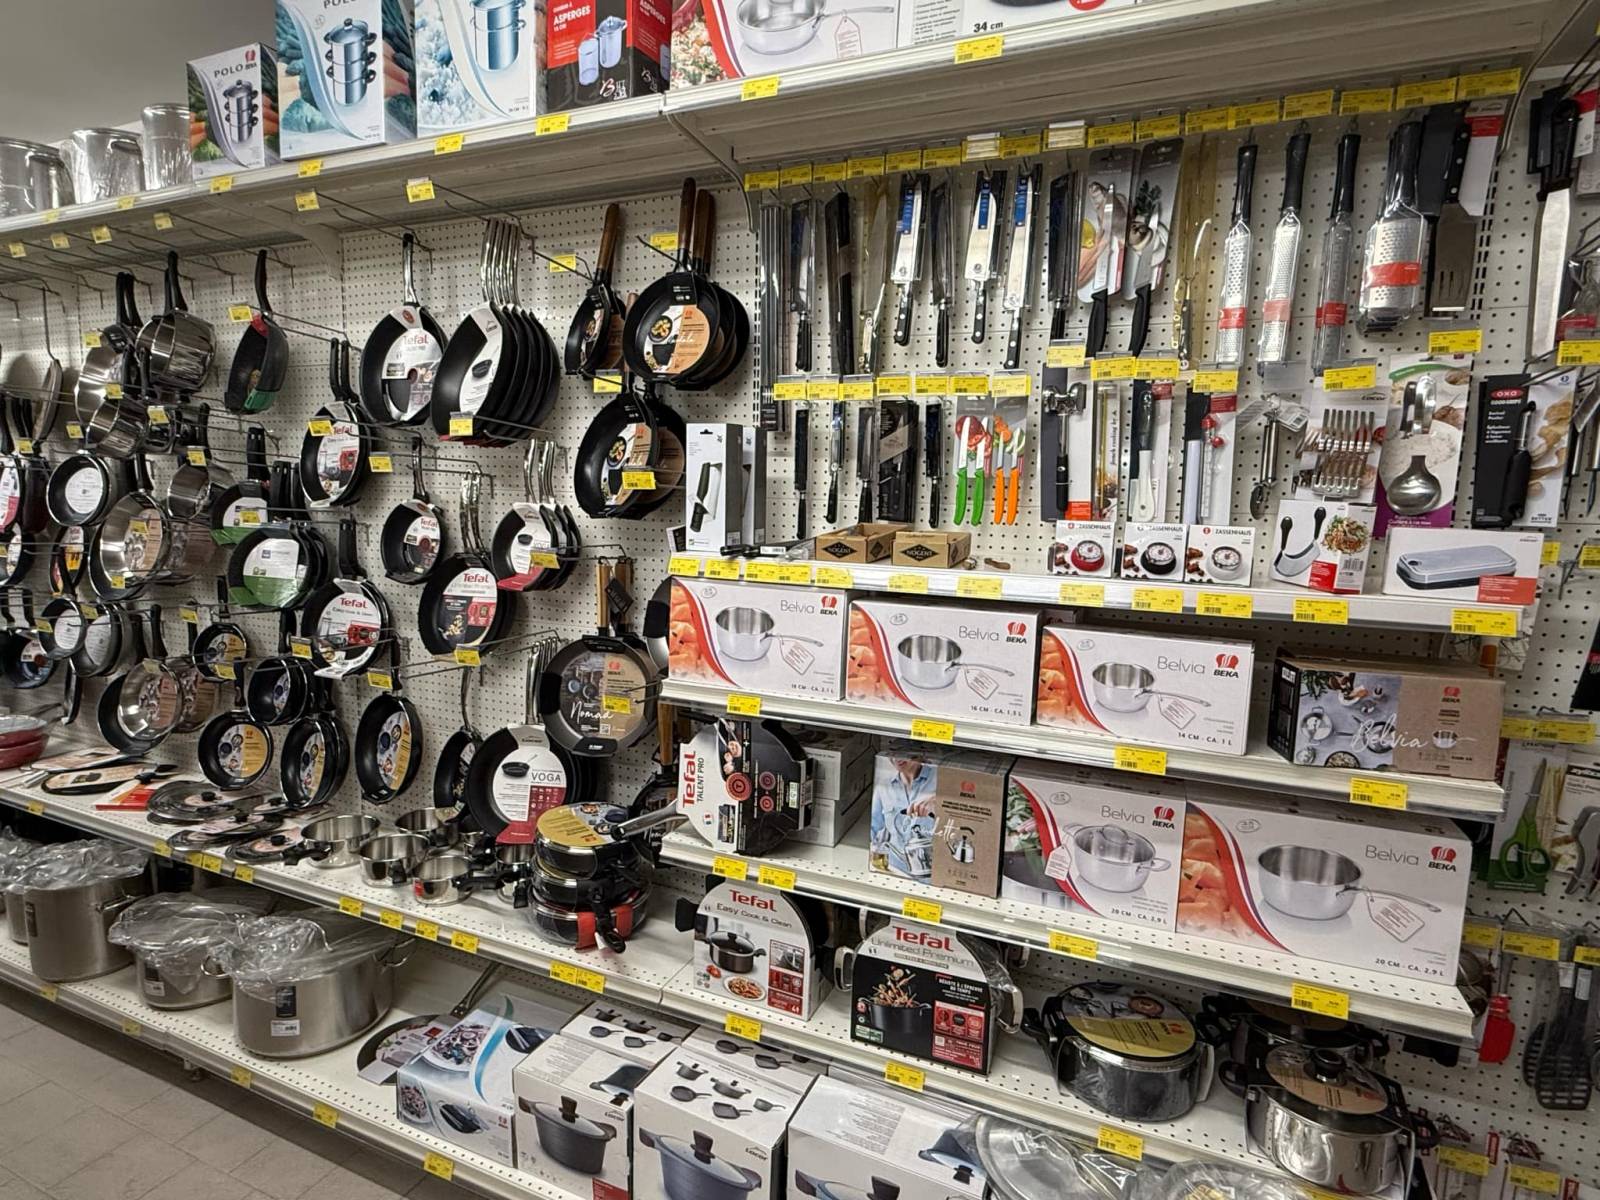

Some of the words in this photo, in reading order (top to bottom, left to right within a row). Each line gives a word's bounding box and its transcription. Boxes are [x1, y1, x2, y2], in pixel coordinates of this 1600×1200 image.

[553, 5, 591, 25] ASPERGES
[973, 21, 987, 33] 34
[990, 21, 1004, 30] cm
[214, 64, 243, 78] POLO
[463, 573, 489, 583] Tefal
[340, 597, 368, 608] Tefal
[780, 600, 815, 614] Belvia
[959, 625, 999, 641] Belvia
[1006, 636, 1027, 644] BEKA
[1157, 656, 1205, 674] Belvia
[1213, 669, 1239, 678] BEKA
[570, 700, 614, 724] Nomad
[1350, 713, 1427, 753] Belvia
[531, 772, 561, 782] VOGA
[683, 750, 696, 808] Tefal
[1101, 805, 1145, 824] Belvia
[1152, 820, 1175, 829] BEKA
[1365, 845, 1419, 866] Belvia
[1428, 861, 1457, 872] BEKA
[729, 889, 777, 912] Tefal
[716, 903, 739, 914] Easy
[741, 910, 760, 921] Cook
[770, 918, 792, 928] Clean
[892, 926, 954, 952] Tefal
[871, 938, 920, 954] Unlimited
[922, 947, 974, 967] Premium
[1375, 958, 1386, 966] 20
[1387, 960, 1400, 968] CM
